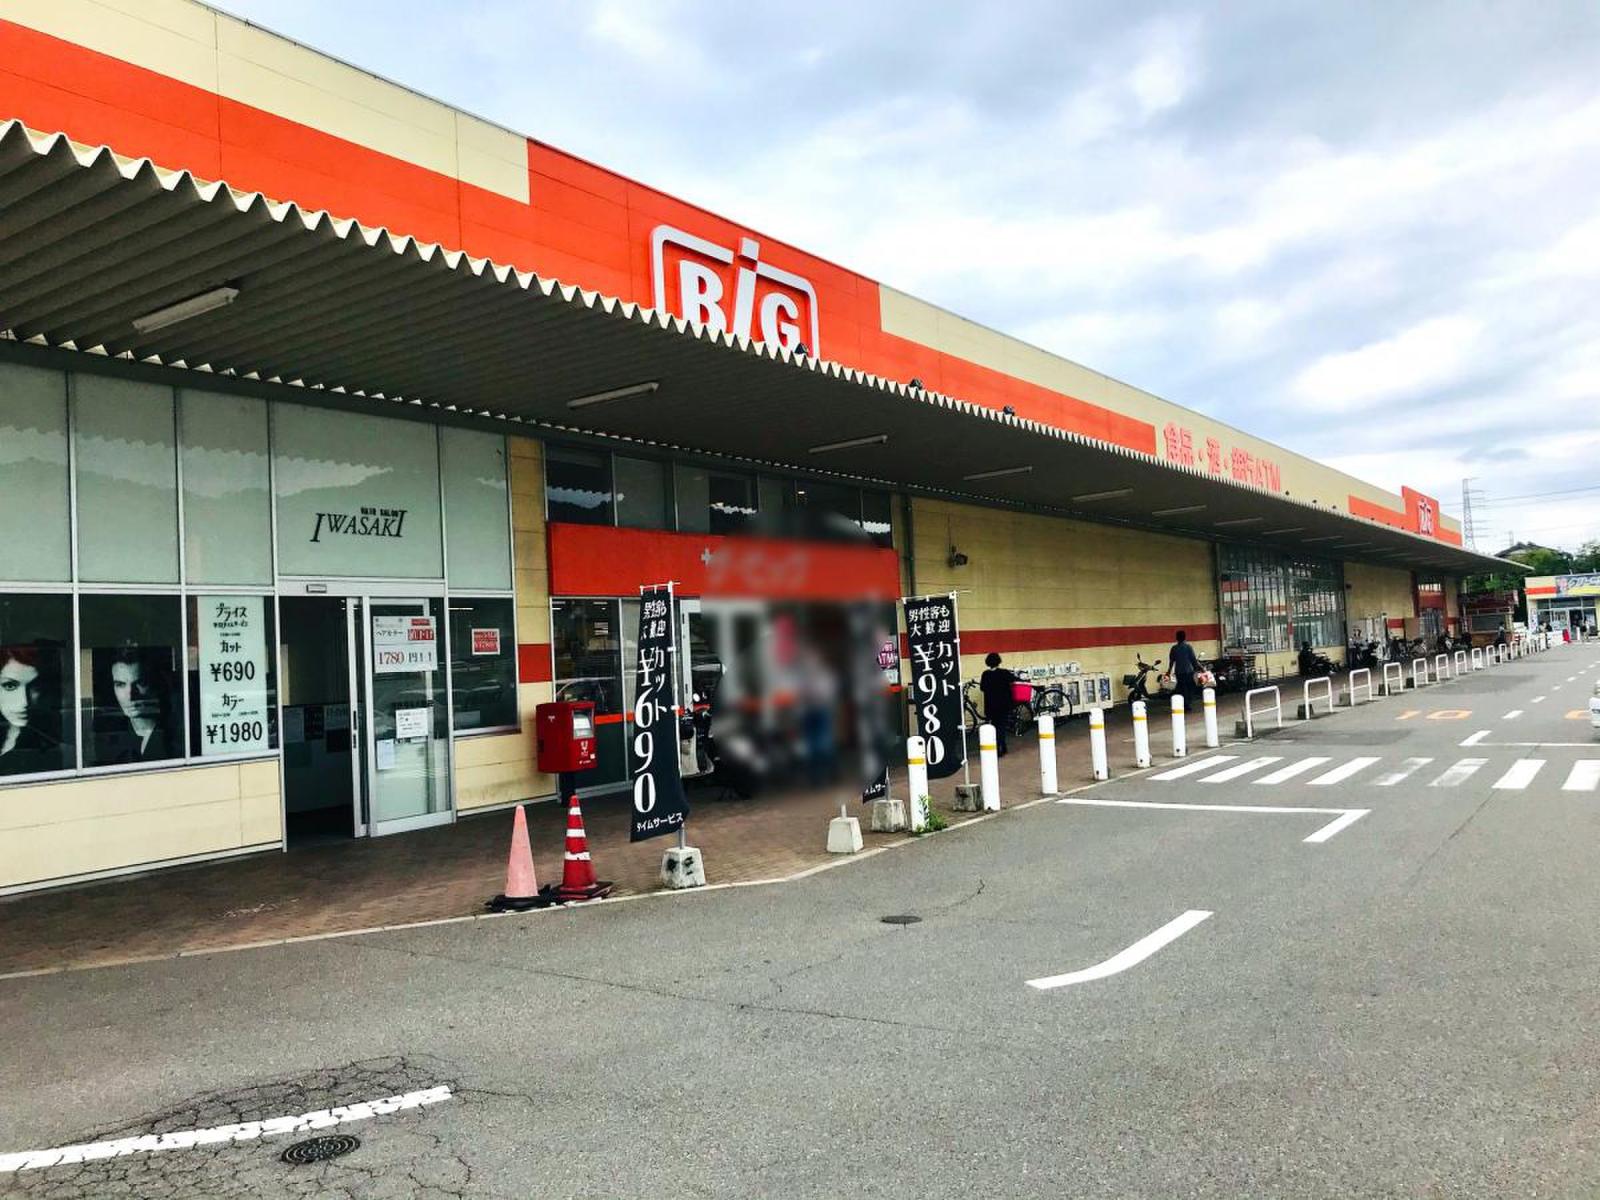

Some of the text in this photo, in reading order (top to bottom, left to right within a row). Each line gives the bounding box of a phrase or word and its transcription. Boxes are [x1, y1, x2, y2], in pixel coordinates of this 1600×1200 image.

[309, 509, 408, 542] IWASAKI
[215, 602, 248, 622] プライス
[908, 604, 951, 624] 男性客も
[220, 639, 242, 654] カット
[209, 660, 256, 683] ¥690
[935, 641, 956, 697] カット
[653, 645, 668, 722] カット
[221, 692, 245, 712] カラー
[912, 642, 945, 766] ¥980
[205, 720, 263, 745] ¥1980
[634, 647, 657, 814] ¥690
[636, 811, 685, 833] タイムサービス
